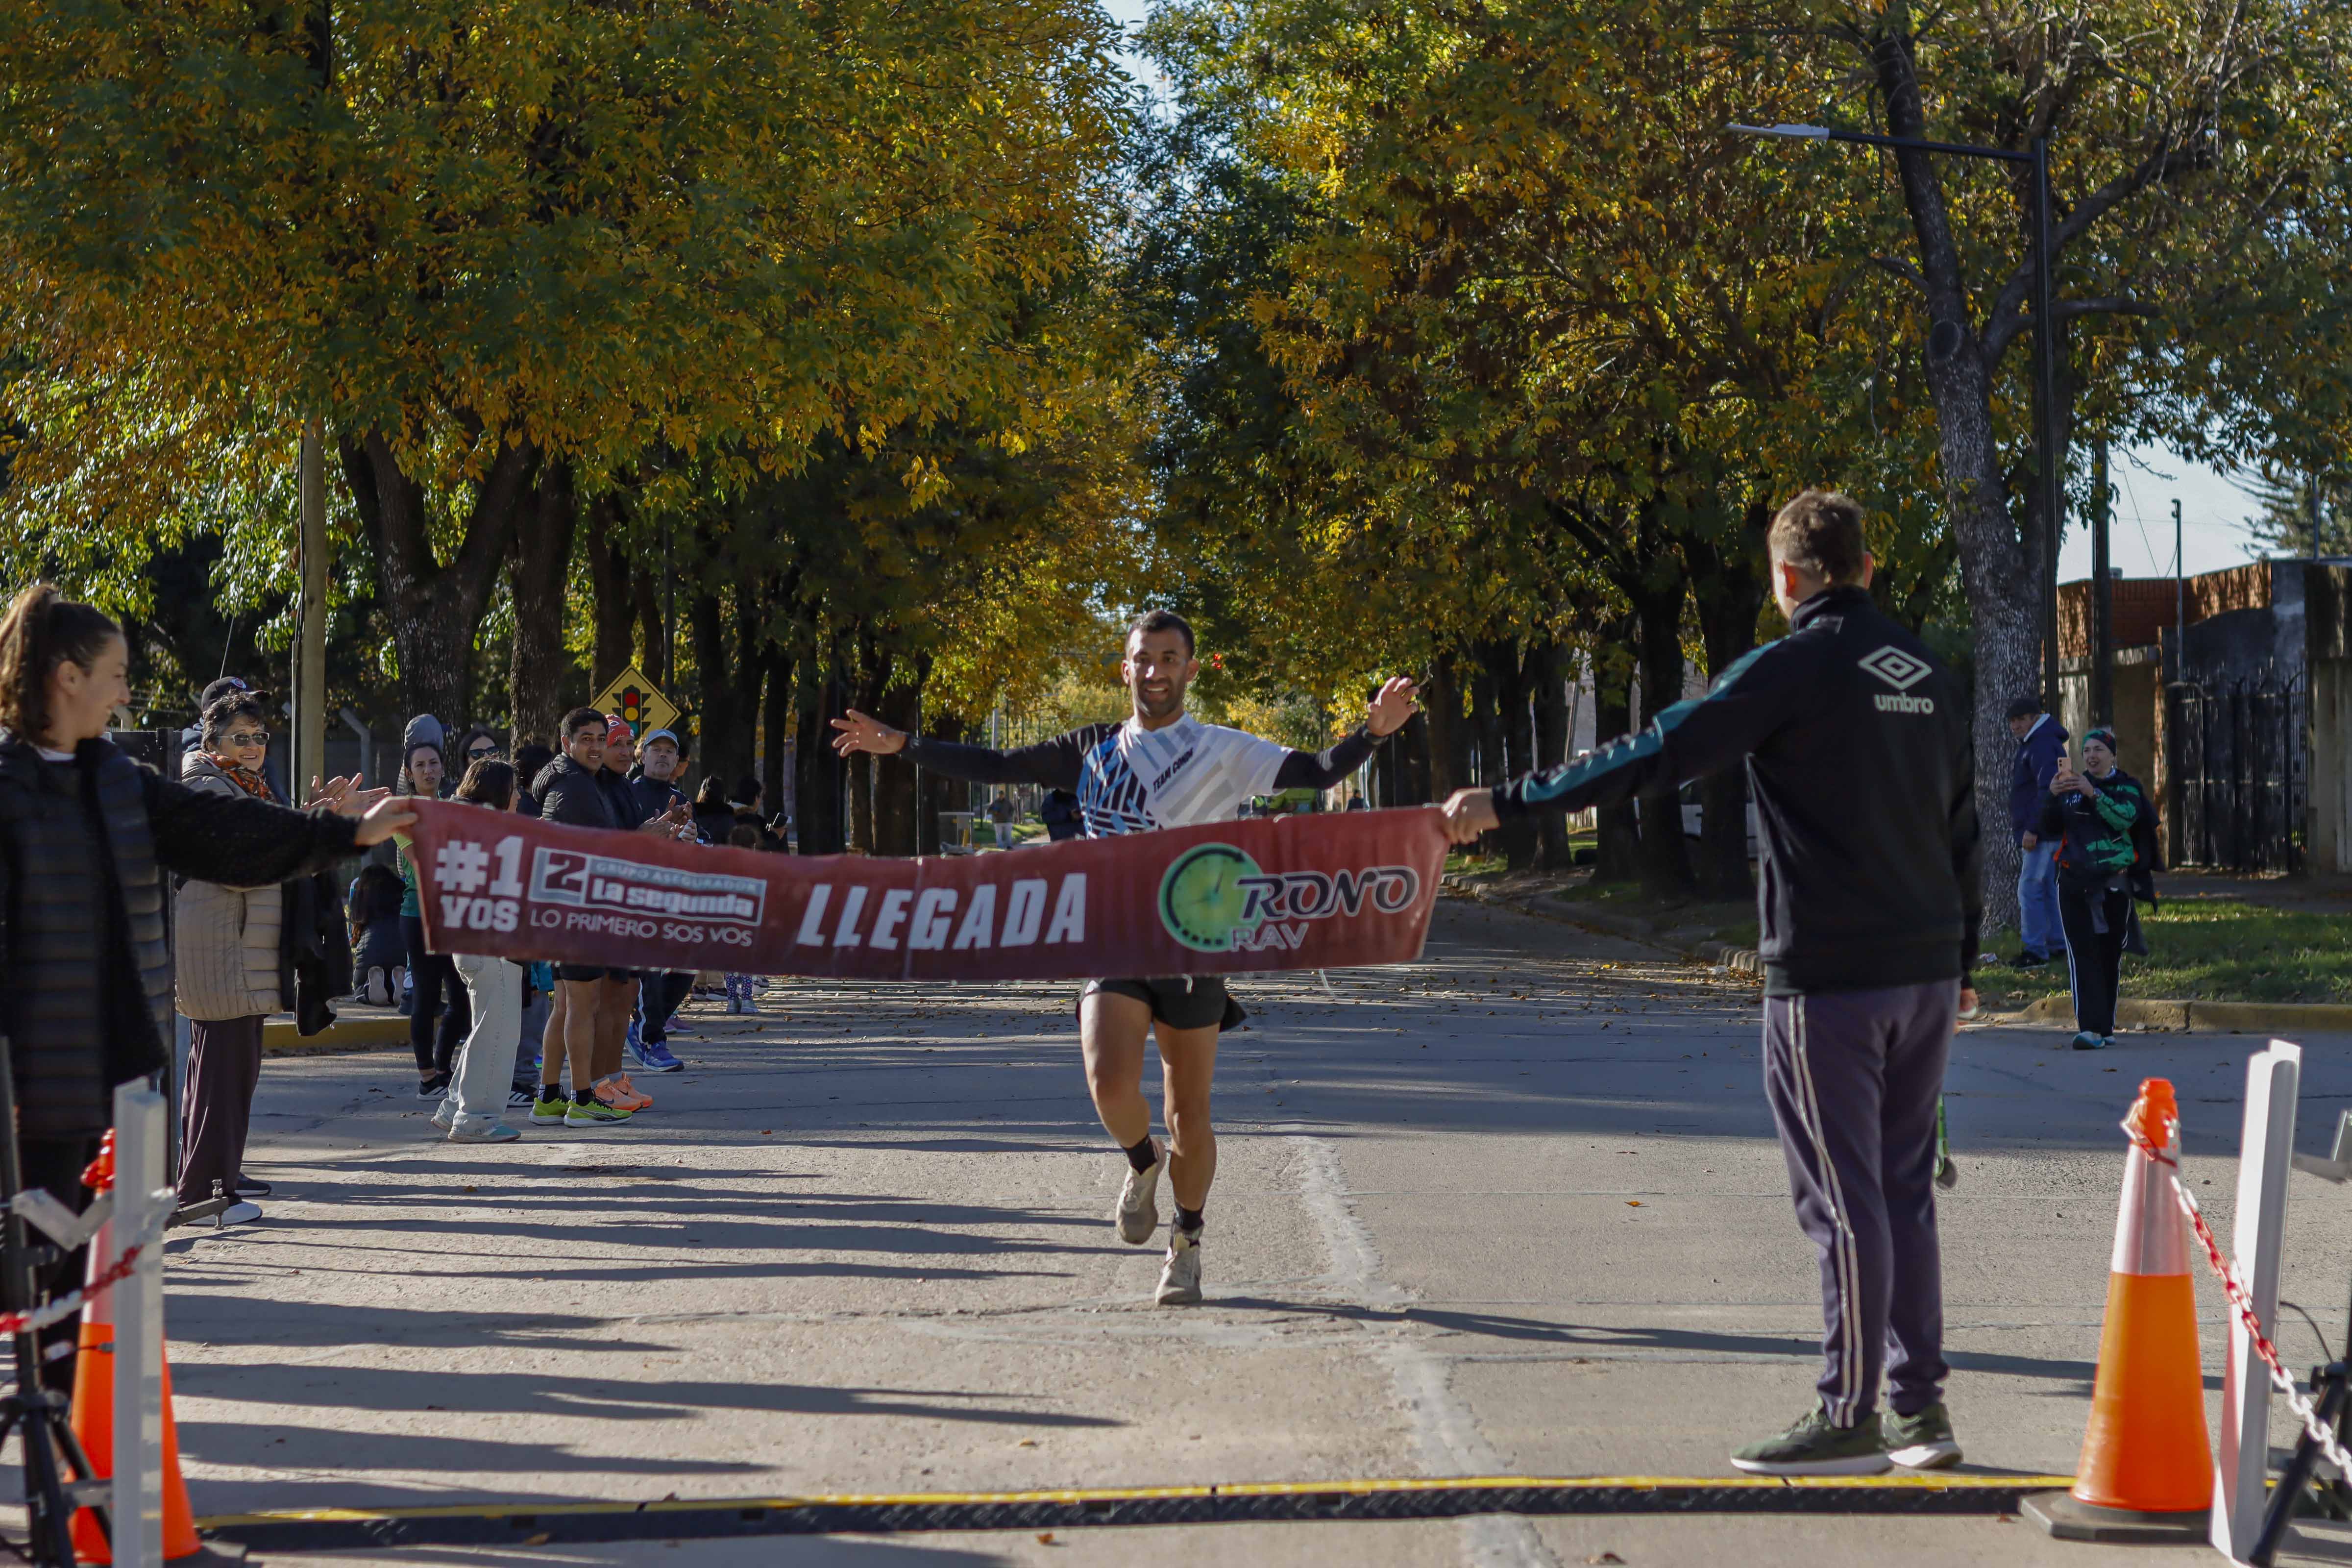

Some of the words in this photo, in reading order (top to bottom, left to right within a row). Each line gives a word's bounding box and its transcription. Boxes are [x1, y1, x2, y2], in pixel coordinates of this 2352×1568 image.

[1873, 691, 1935, 715] umbro
[1153, 766, 1172, 793] TEAM
[434, 835, 524, 898] #1
[595, 862, 649, 879] GRUPO
[440, 895, 520, 932] VOS
[626, 886, 755, 918] segunda
[796, 872, 1087, 951] LLEGADA
[530, 908, 562, 928] LO
[566, 912, 657, 938] PRIMERO
[662, 922, 704, 943] SOS
[709, 926, 753, 947] VOS
[1230, 922, 1310, 953] RAV
